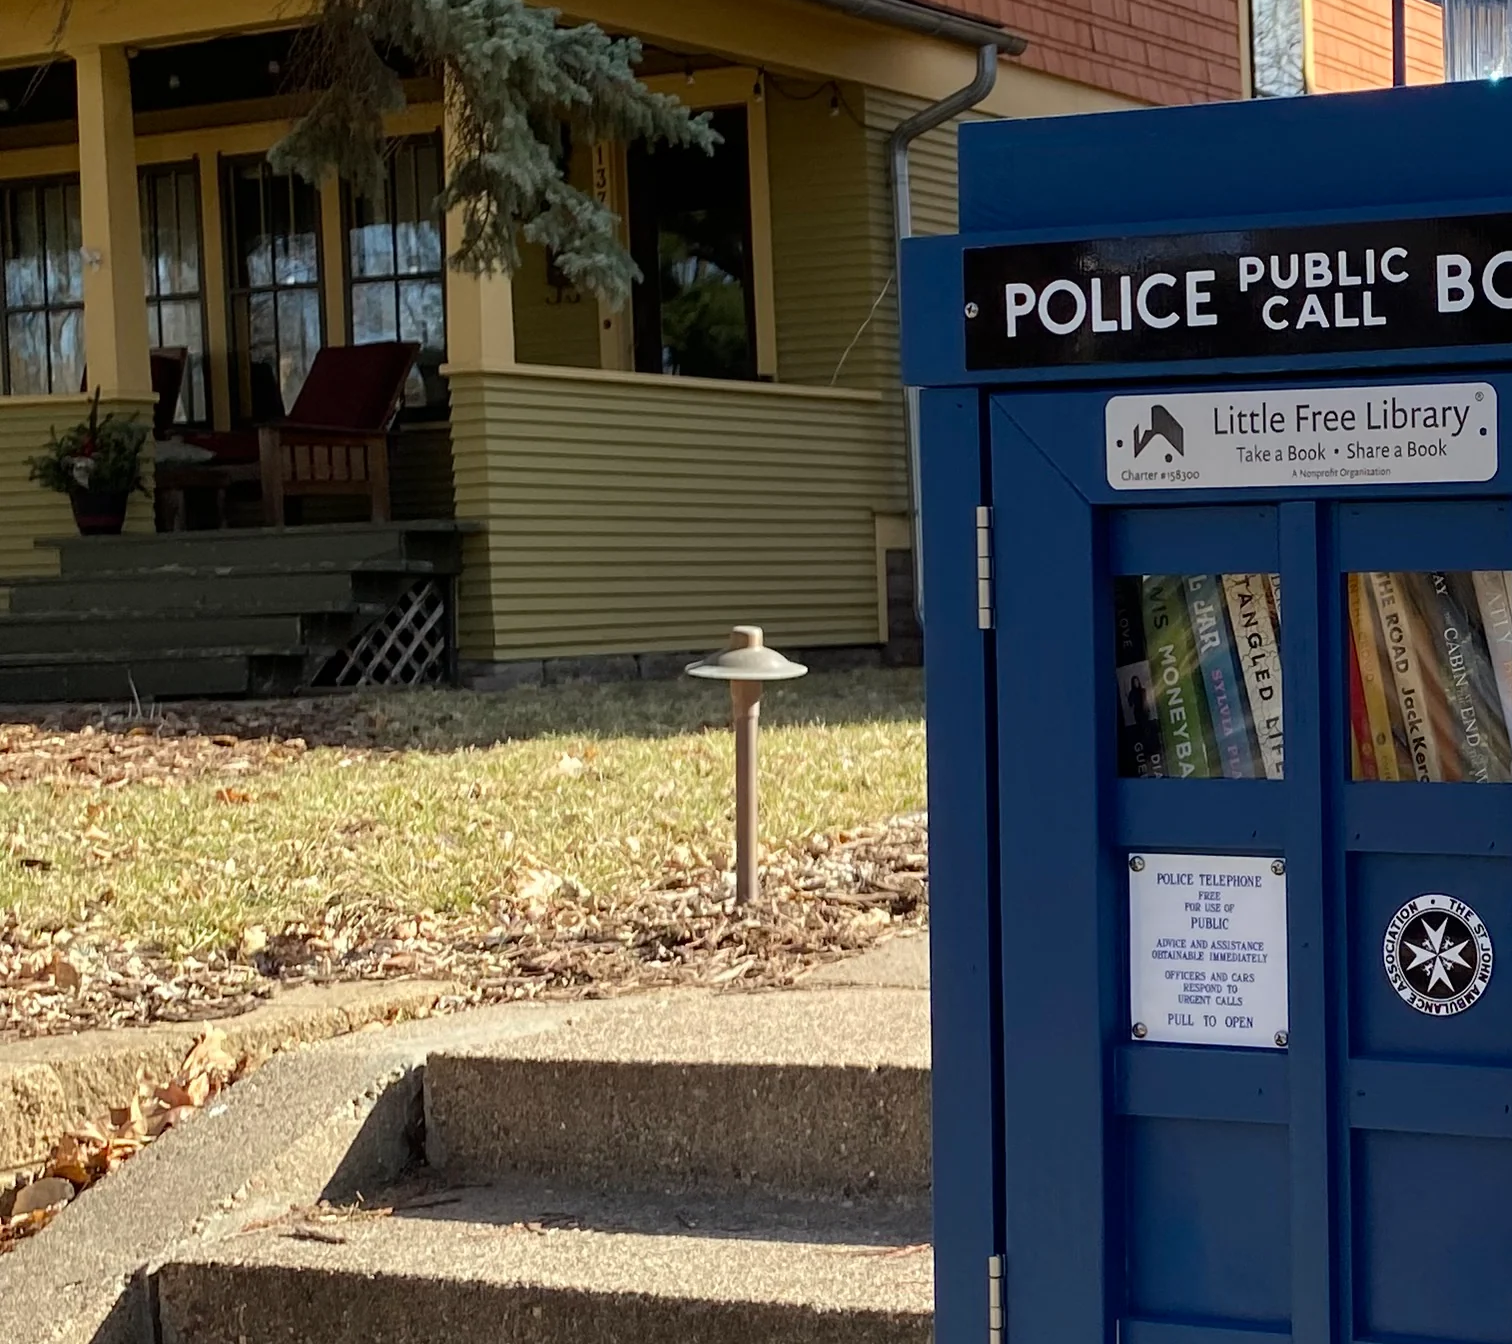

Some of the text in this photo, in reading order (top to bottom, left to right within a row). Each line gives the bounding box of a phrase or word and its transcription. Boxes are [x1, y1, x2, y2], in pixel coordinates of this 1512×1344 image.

[1238, 246, 1410, 292] PUBLIC
[1005, 269, 1218, 338] POLICE
[1261, 291, 1387, 331] CALL
[1213, 402, 1286, 436] Little
[1295, 404, 1356, 433] Free
[1366, 397, 1470, 438] Library
[1235, 438, 1448, 463] Take a Book Share a Book
[1121, 469, 1158, 481] Charter
[1291, 466, 1391, 480] A Nonprofit Organization
[1236, 574, 1274, 702] TANGLED
[1193, 600, 1221, 653] JAR
[1210, 668, 1234, 737] SYLVIA
[1385, 612, 1409, 674] ROAD
[1401, 687, 1424, 733] Jack
[1443, 626, 1469, 687] CABIN
[1460, 707, 1482, 748] END
[1158, 643, 1196, 779] MONEYBA
[1156, 872, 1262, 888] POLICE TELEPHONE
[1184, 902, 1235, 913] FOR USE OF
[1198, 891, 1221, 901] FREE
[1449, 898, 1475, 922] THE
[1190, 917, 1230, 930] PUBLIC
[1151, 950, 1268, 963] OBTAINABLE IMMEDIATELY
[1156, 938, 1264, 951] ADVICE AND ASSISTANCE
[1385, 901, 1420, 992] ASSOCIATION
[1478, 943, 1492, 984] JOHN
[1164, 970, 1255, 983] OFFICERS AND CARS
[1177, 994, 1243, 1007] URGENT CALLS
[1183, 984, 1238, 994] RESPOND TO
[1406, 983, 1482, 1015] AMBULANCE
[1167, 1013, 1255, 1029] PULL TO OPEN
